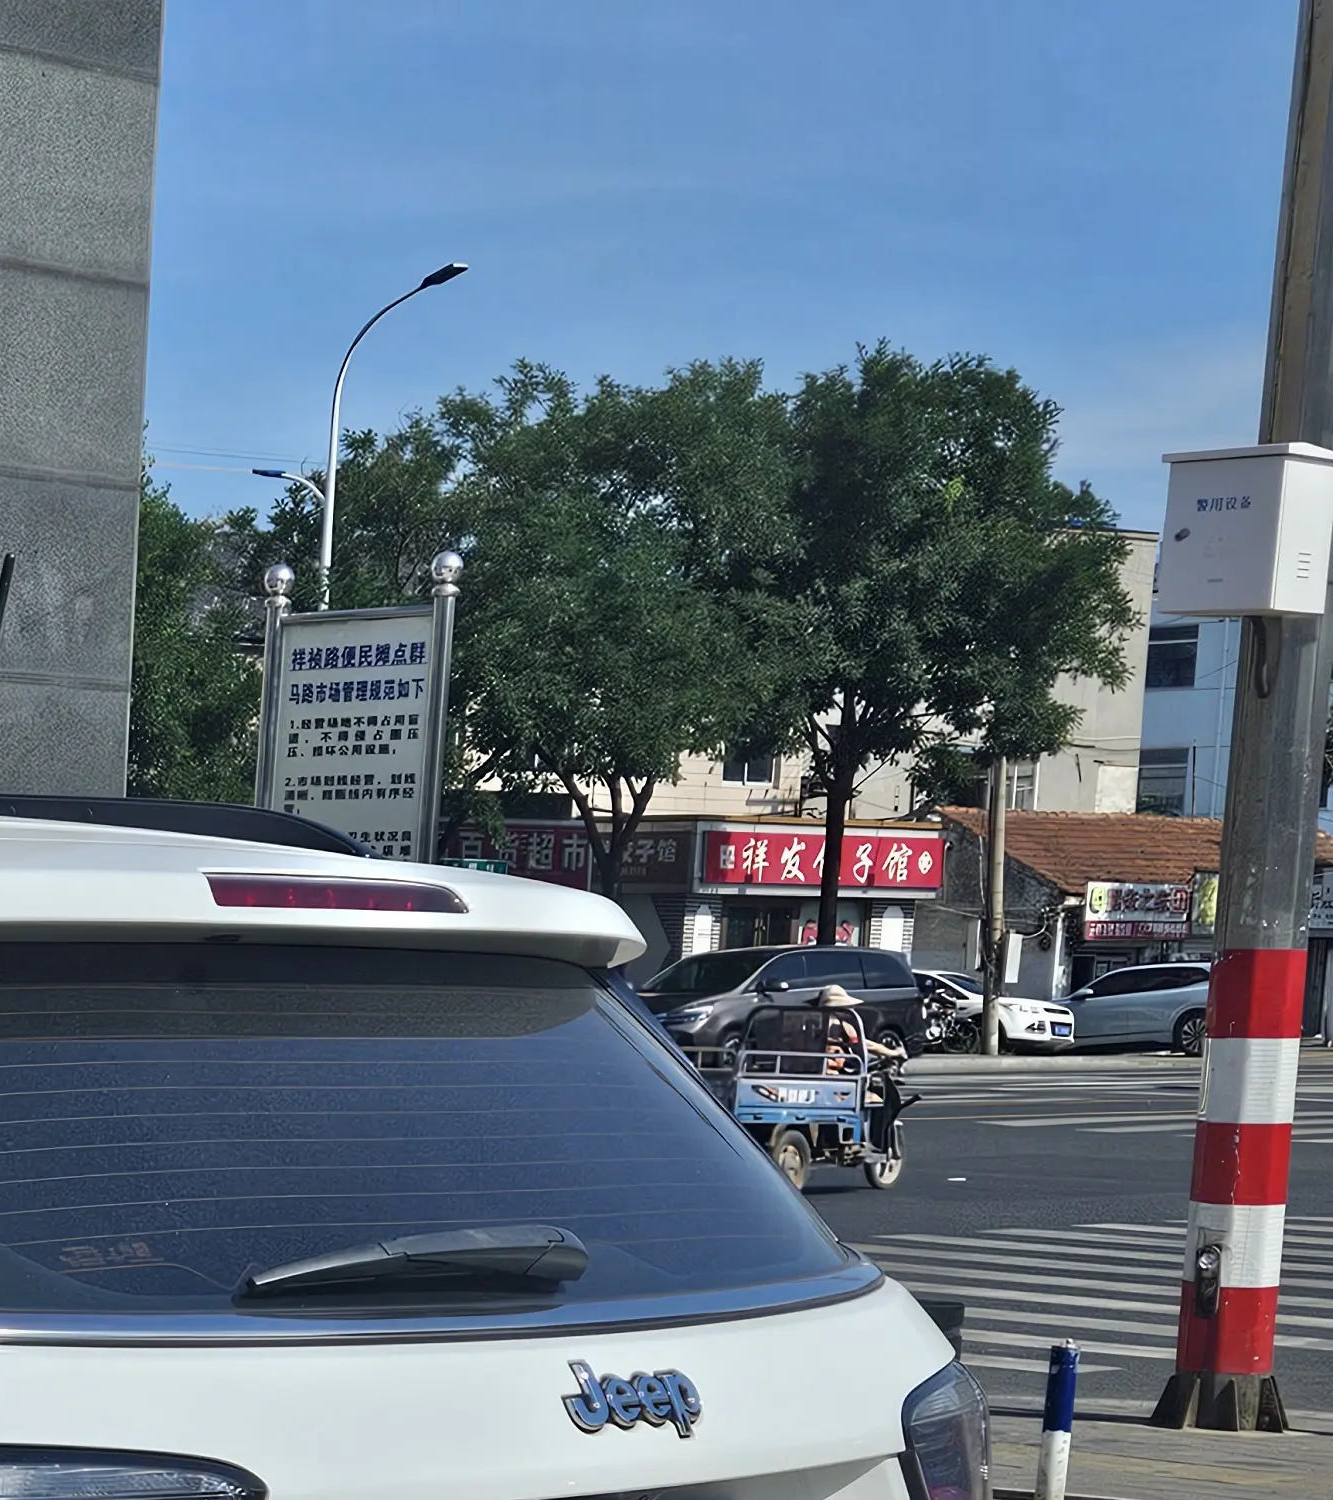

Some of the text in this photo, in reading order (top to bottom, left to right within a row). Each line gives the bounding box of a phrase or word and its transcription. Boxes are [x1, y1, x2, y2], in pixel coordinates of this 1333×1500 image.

[742, 836, 914, 883] 祥发子馆
[561, 1359, 703, 1440] Jeep
